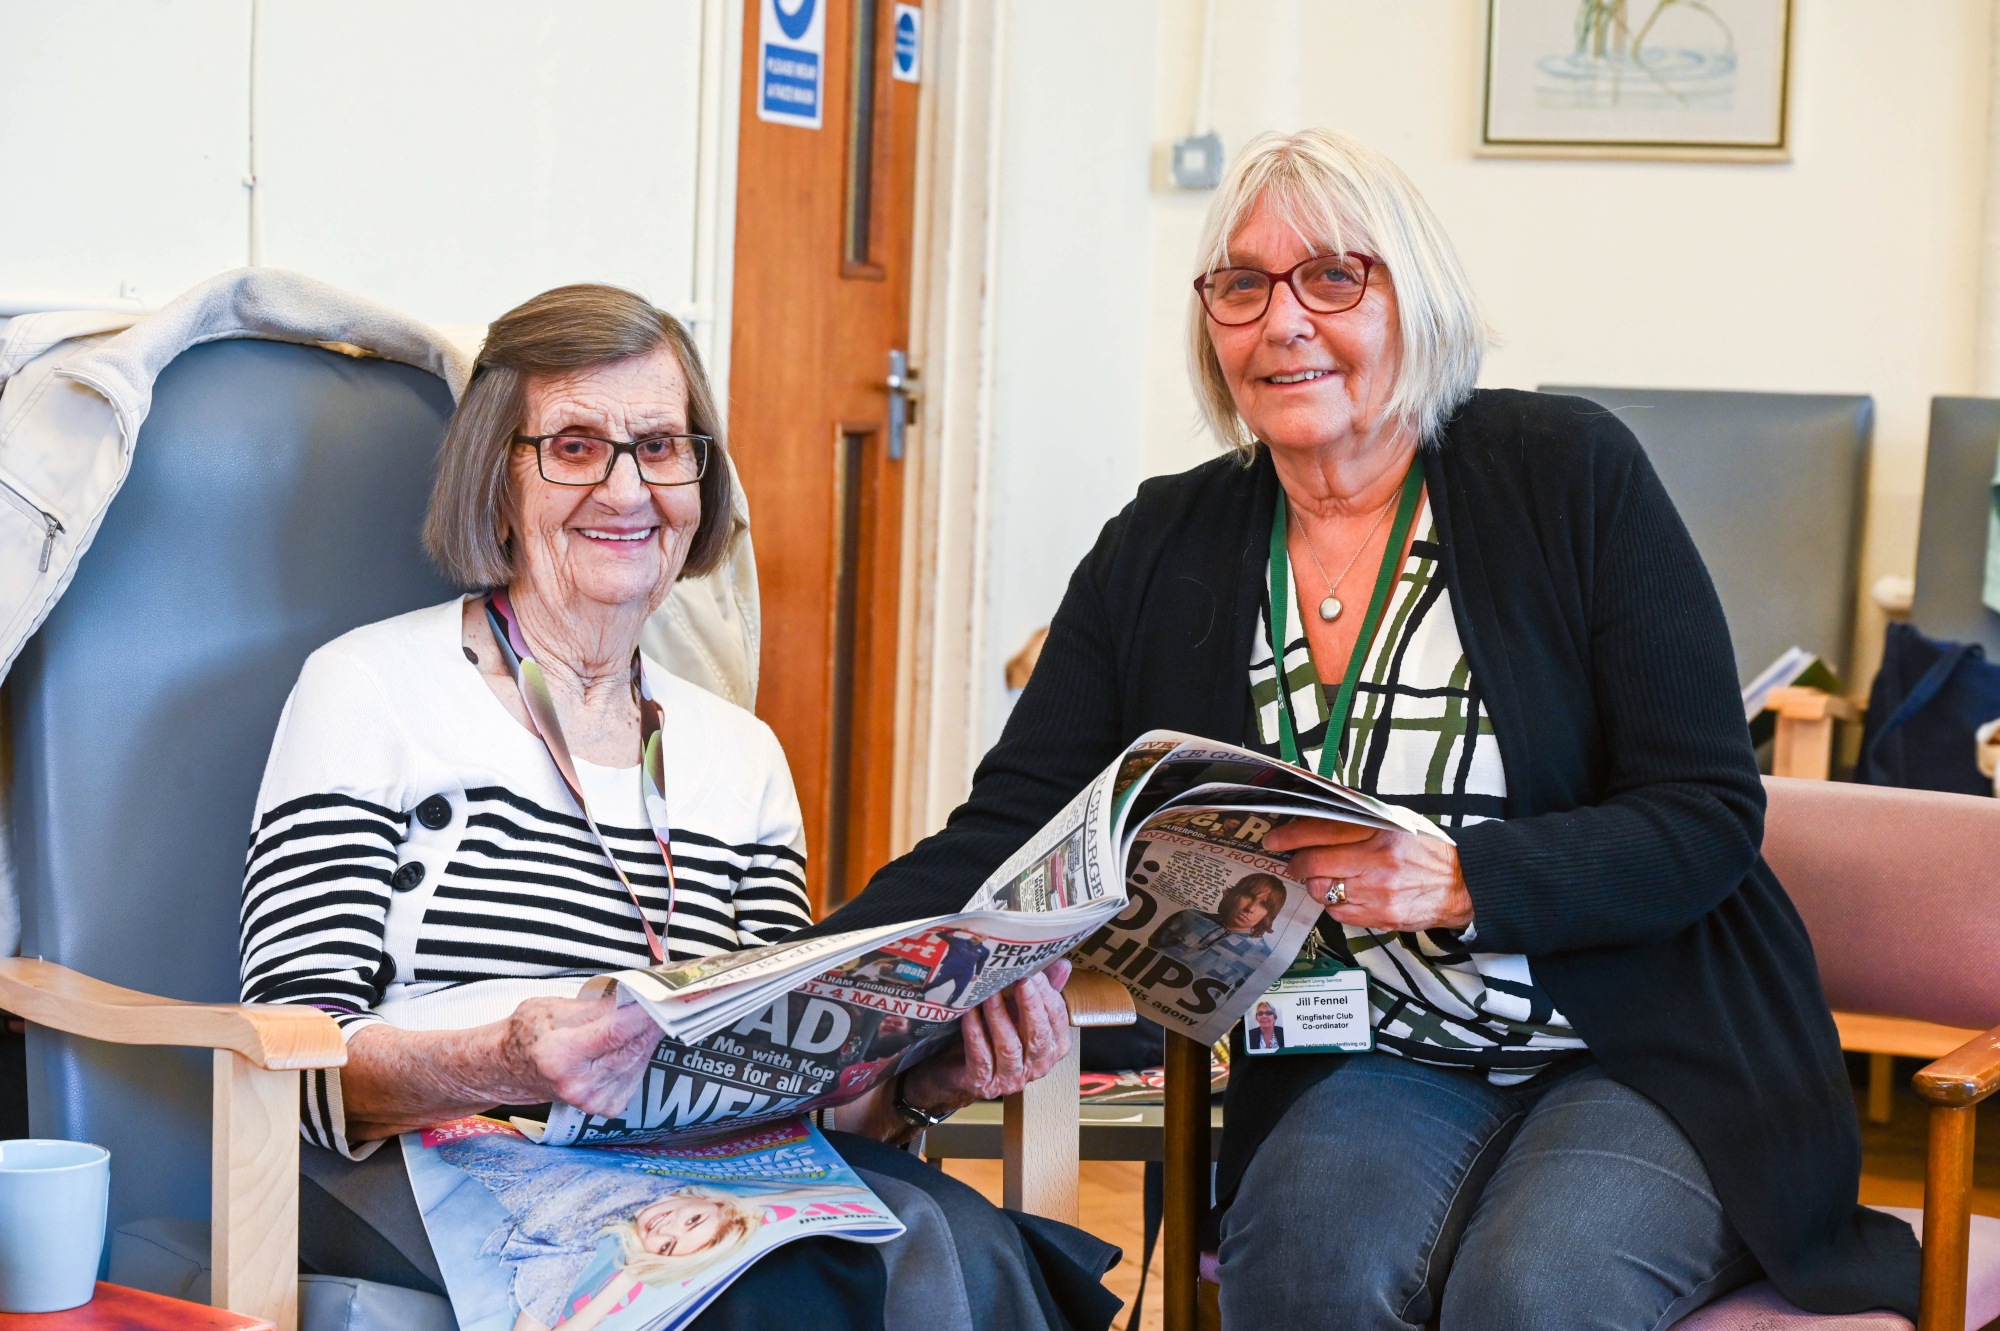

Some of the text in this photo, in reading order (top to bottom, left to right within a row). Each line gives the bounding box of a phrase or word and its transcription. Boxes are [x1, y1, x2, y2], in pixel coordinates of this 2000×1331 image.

[1198, 843, 1224, 853] TO
[1225, 850, 1297, 882] ROCKE
[994, 943, 1032, 957] PEP
[988, 956, 1011, 967] 71
[895, 963, 928, 979] goals
[856, 981, 915, 998] PROMOTED
[829, 986, 843, 998] 4
[849, 991, 912, 1014] MAN
[1296, 995, 1348, 1006] Jill Fennel
[1152, 1001, 1198, 1026] agony
[1296, 1012, 1353, 1022] Kingfisher Club
[1302, 1022, 1348, 1030] Co-ordinator
[712, 1035, 745, 1056] Mo
[752, 1050, 792, 1069] with
[798, 1058, 835, 1082] Kop
[657, 1044, 823, 1094] in chase for all 4
